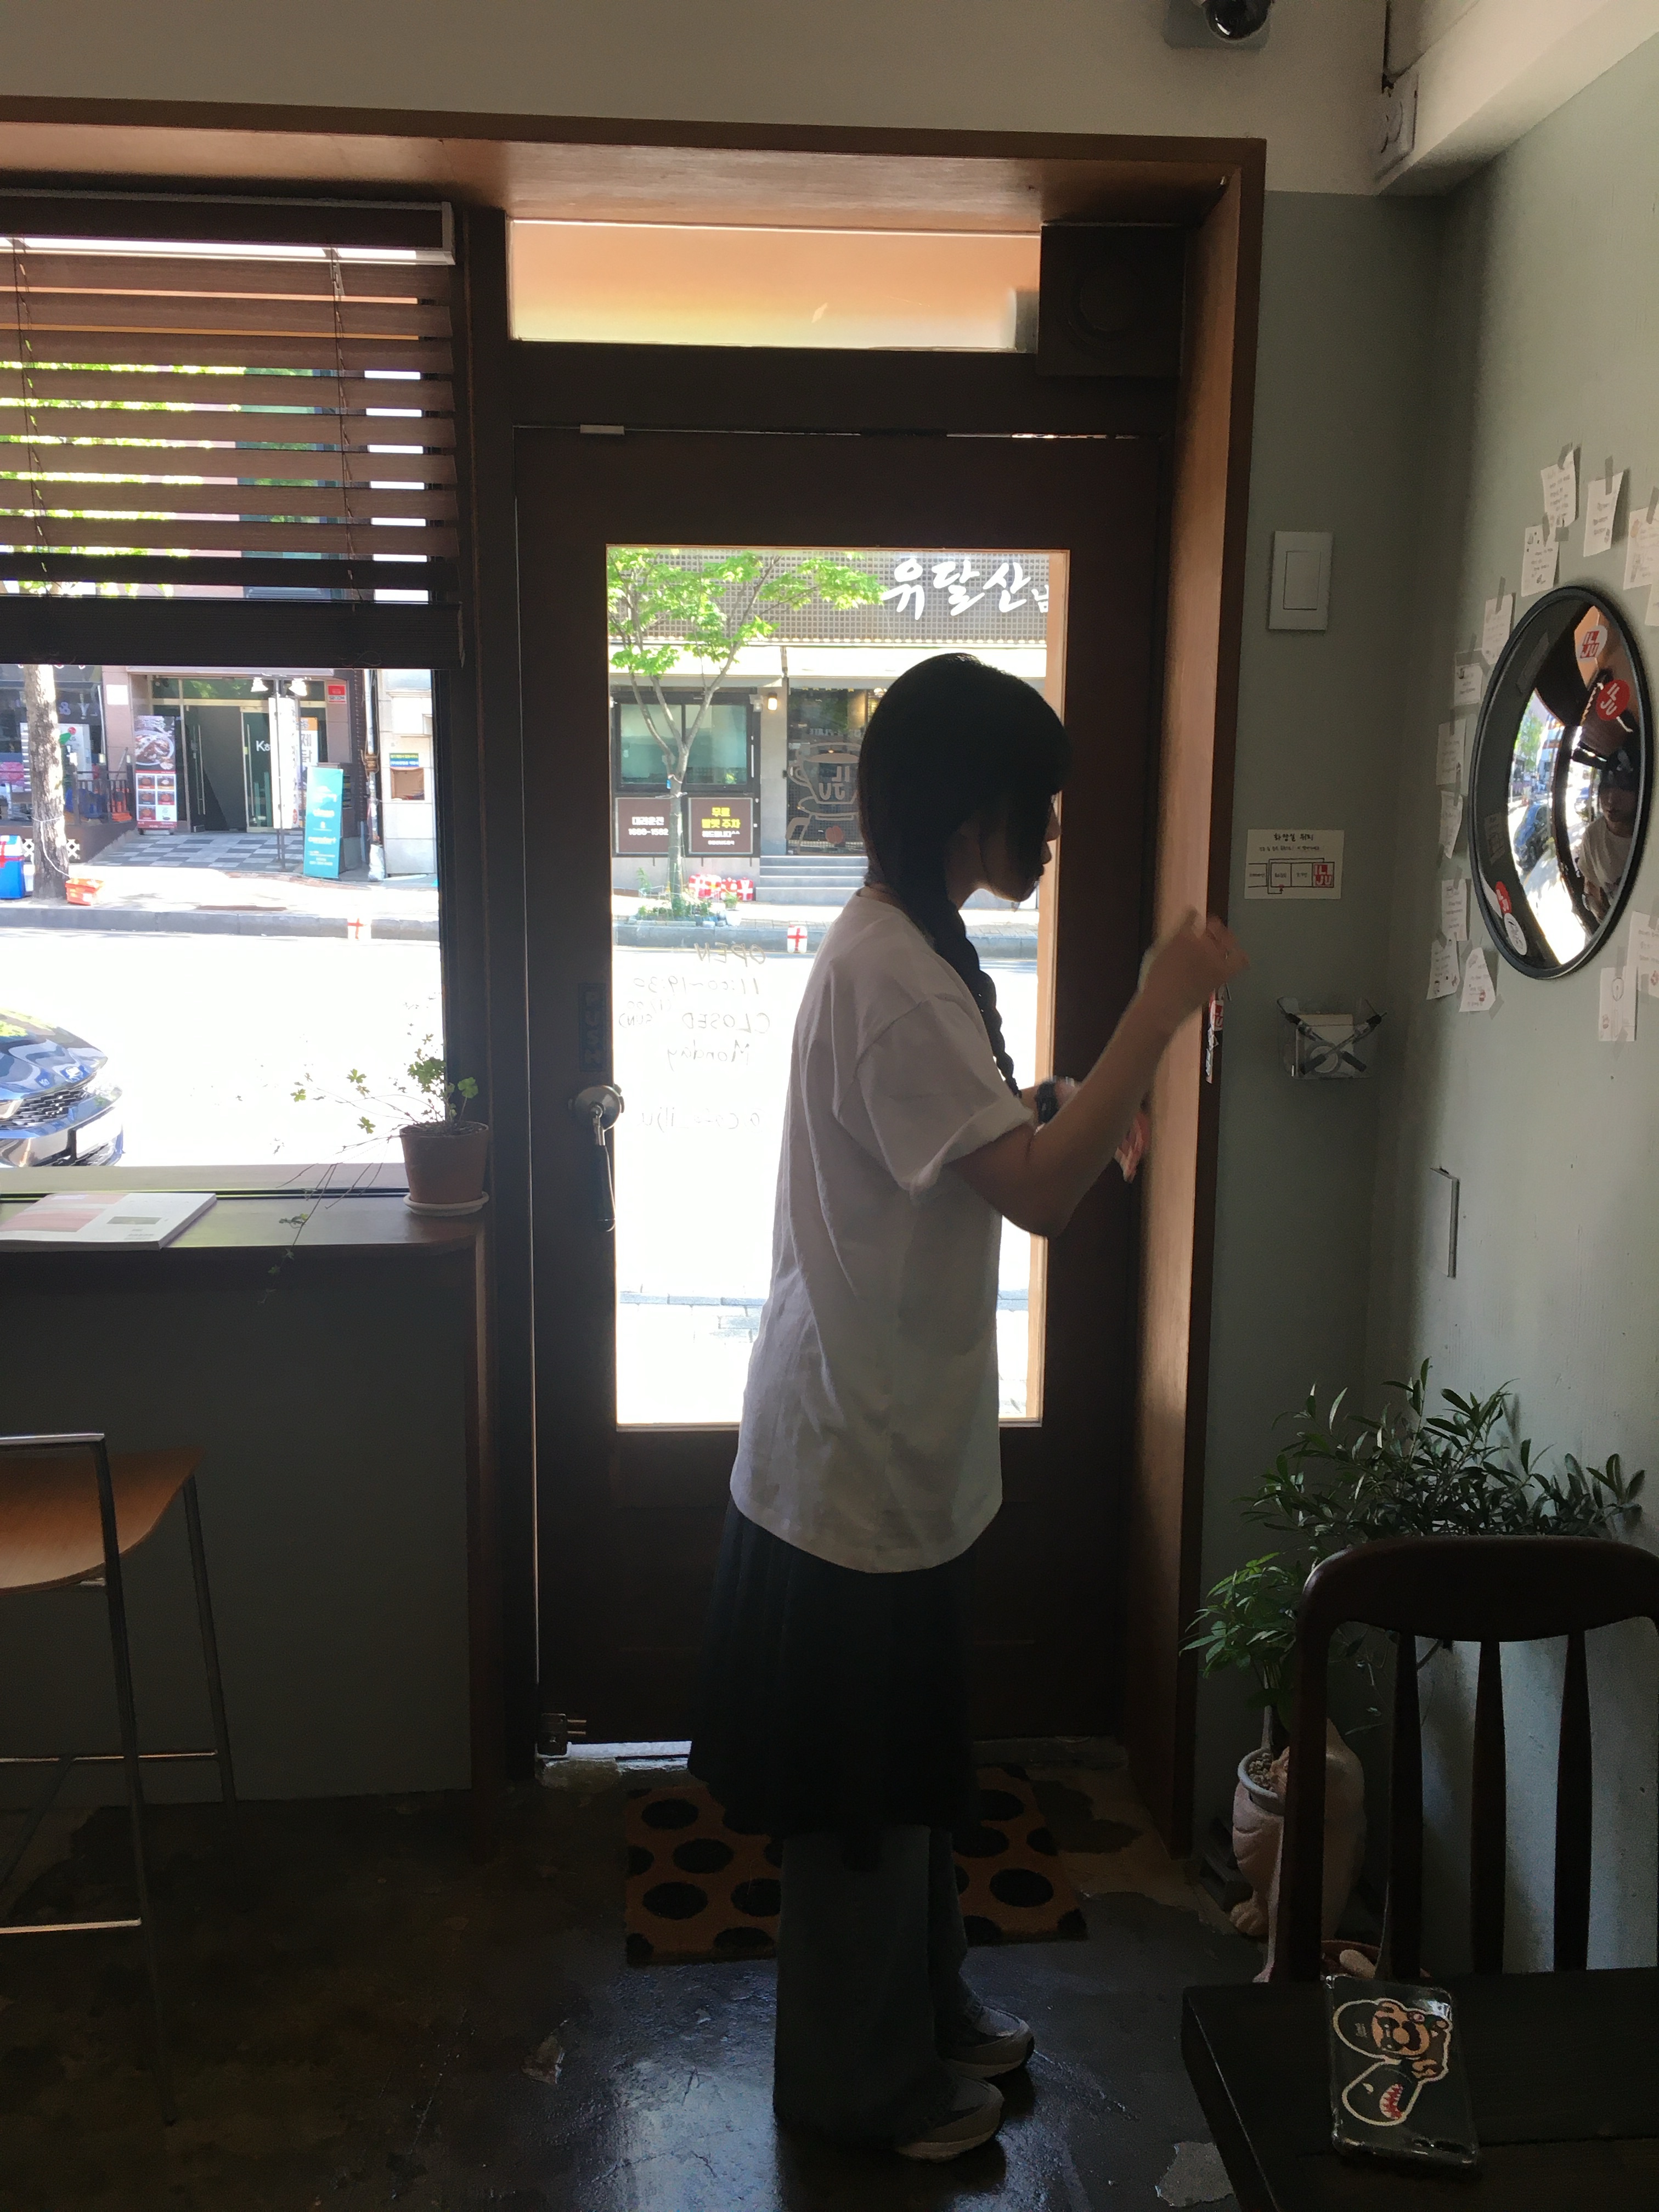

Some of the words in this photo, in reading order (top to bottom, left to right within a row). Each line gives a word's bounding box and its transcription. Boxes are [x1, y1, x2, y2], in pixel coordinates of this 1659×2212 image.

[881, 557, 1031, 620] 유달산
[1607, 682, 1620, 701] IL
[1600, 699, 1617, 715] JU
[712, 808, 730, 817] 무료
[722, 819, 741, 828] 주차
